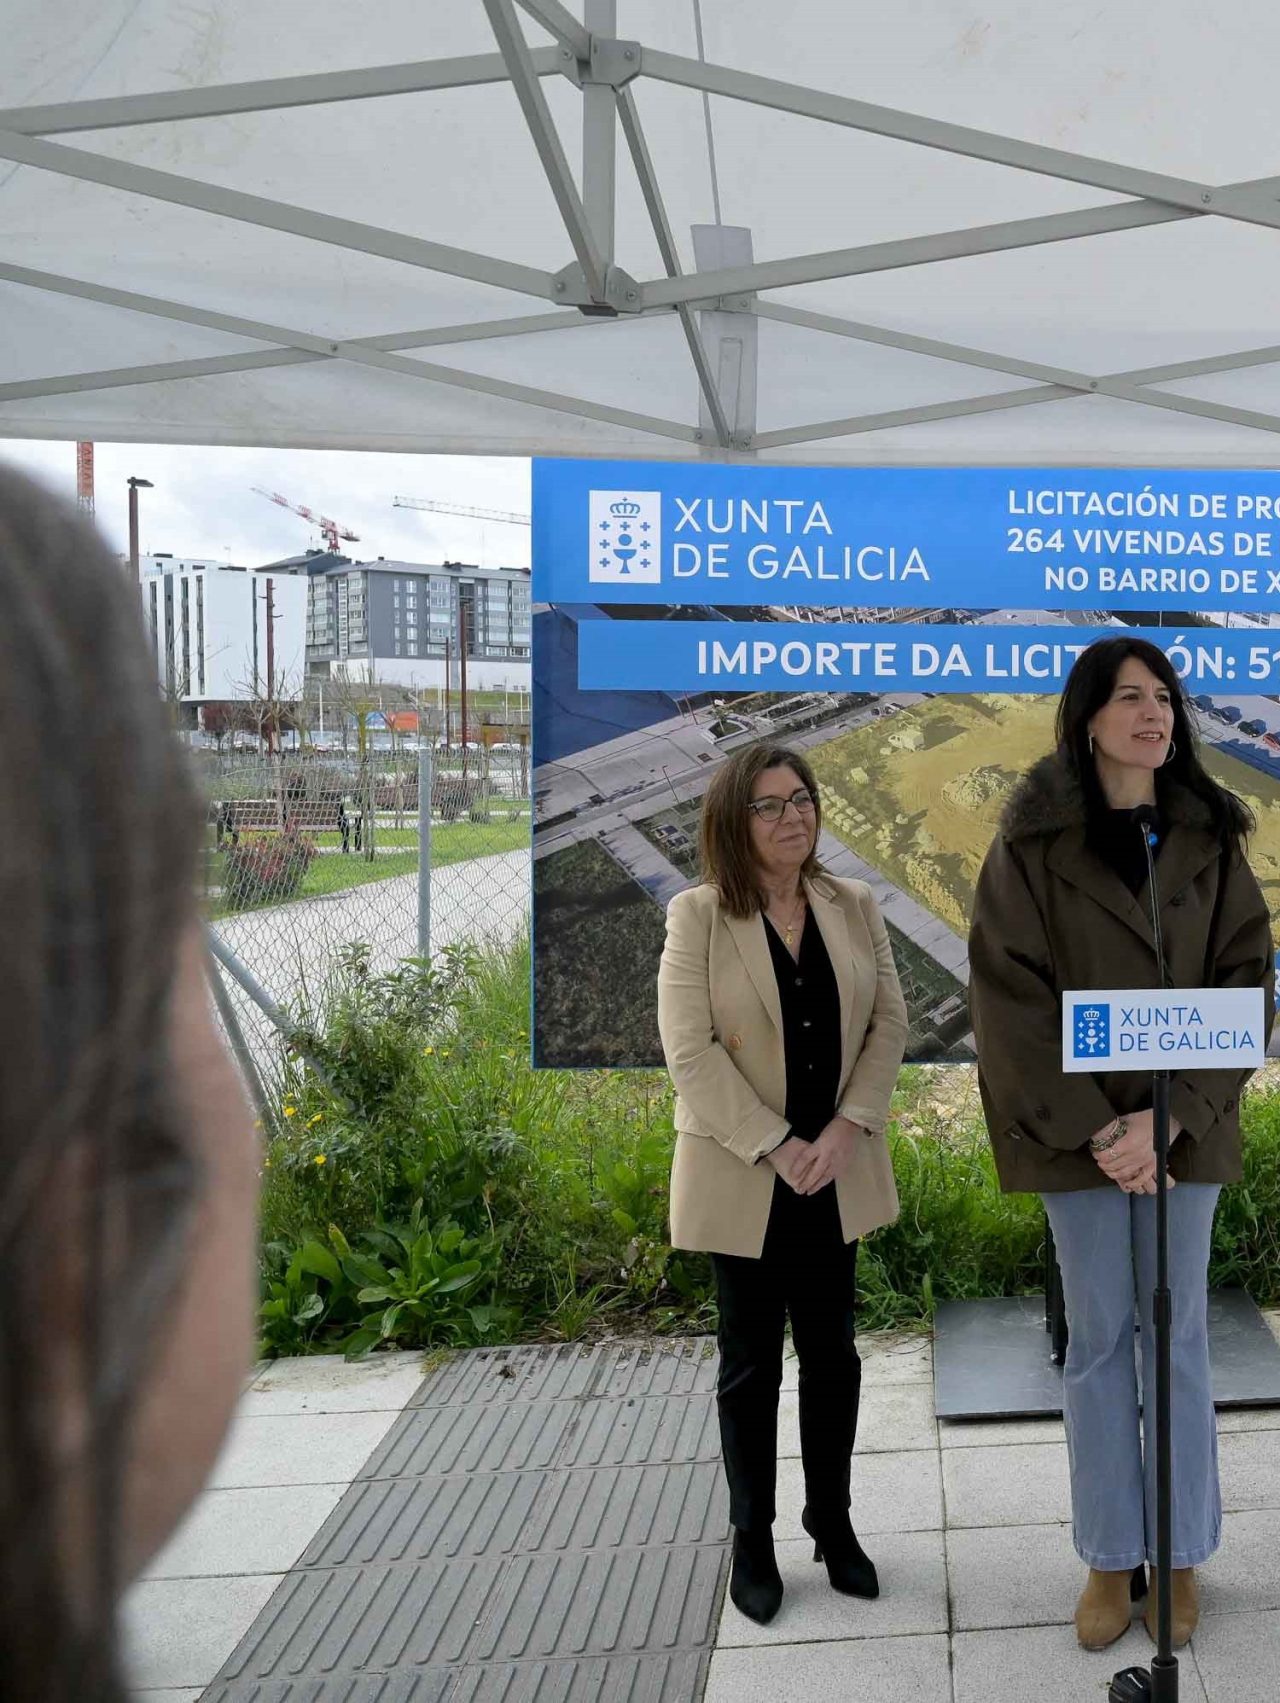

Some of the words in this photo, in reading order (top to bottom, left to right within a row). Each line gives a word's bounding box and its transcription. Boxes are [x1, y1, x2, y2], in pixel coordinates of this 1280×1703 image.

[674, 498, 833, 535] XUNTA
[1009, 485, 1179, 519] LICITACIÓN
[1189, 494, 1228, 519] DE
[1007, 527, 1065, 554] 264
[1072, 529, 1225, 557] VIVENDAS
[1234, 532, 1272, 557] DE
[673, 543, 730, 578] DE
[747, 544, 930, 581] GALICIA
[1045, 566, 1089, 591] NO
[1099, 567, 1211, 593] BARRIO
[1220, 569, 1258, 594] DE
[698, 641, 897, 676] IMPORTE
[912, 643, 972, 677] DA
[986, 635, 1236, 680] LICITÓN:
[1120, 1007, 1204, 1027] XUNTA
[1119, 1032, 1150, 1052] DE
[1158, 1030, 1256, 1051] GALICIA
